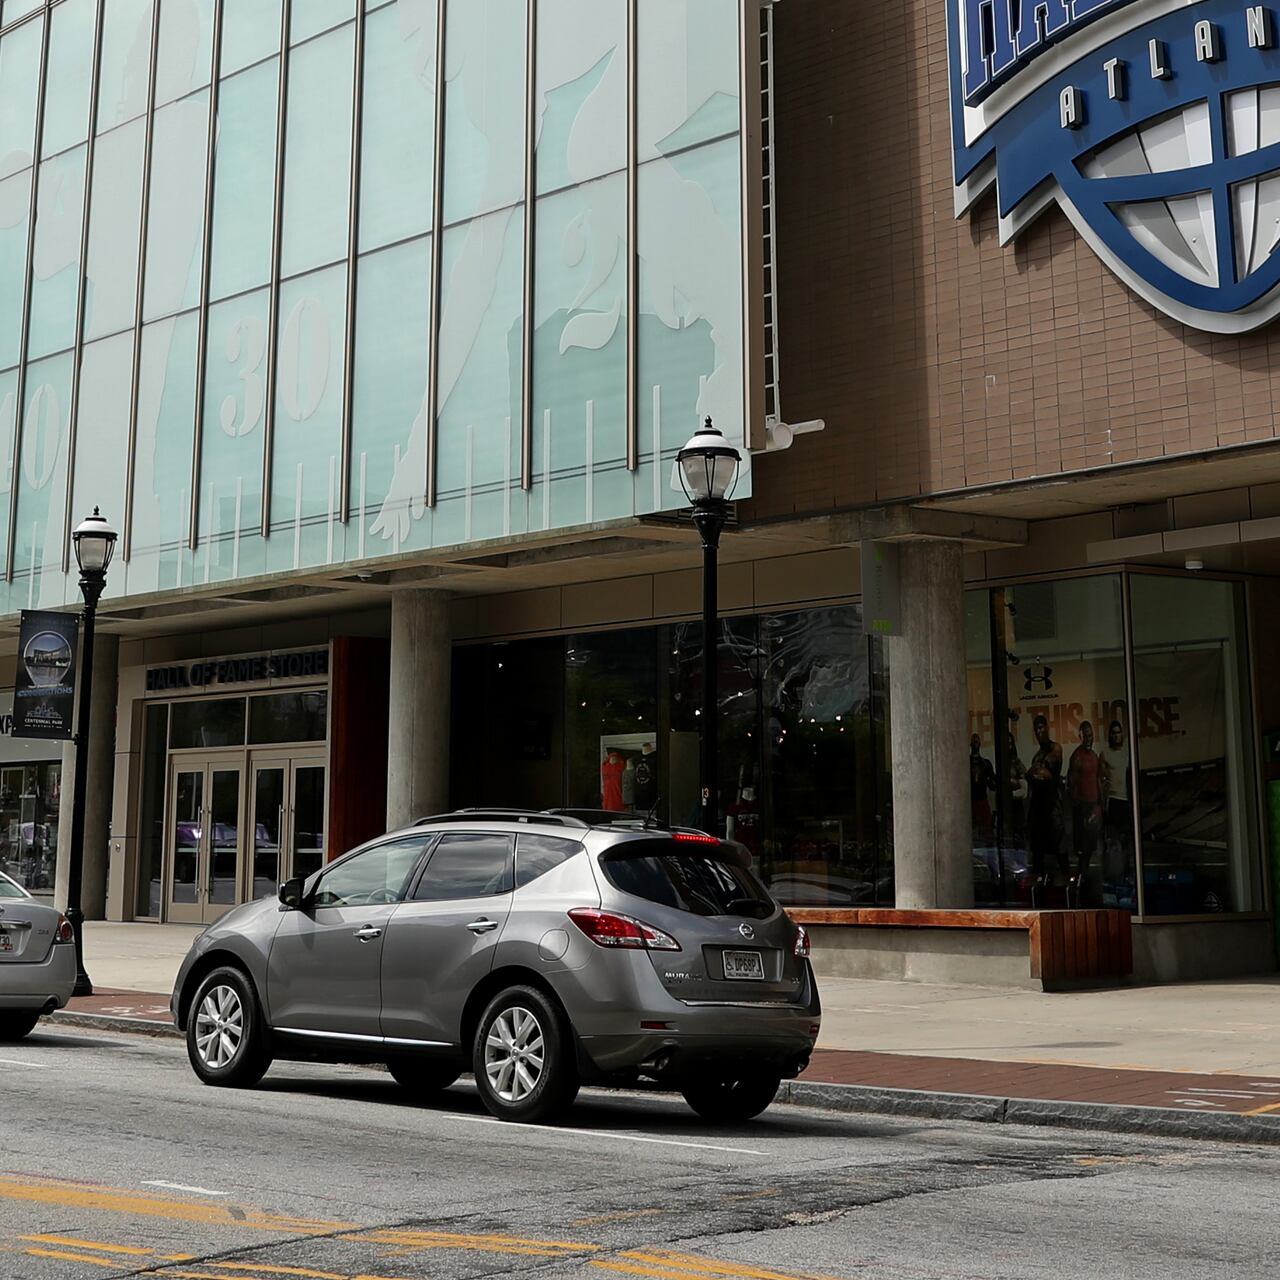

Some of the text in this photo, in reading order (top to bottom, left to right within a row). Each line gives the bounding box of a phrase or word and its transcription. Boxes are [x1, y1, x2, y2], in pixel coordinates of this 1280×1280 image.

[189, 663, 212, 686] OF
[216, 657, 264, 683] FAME
[269, 651, 328, 678] STORE
